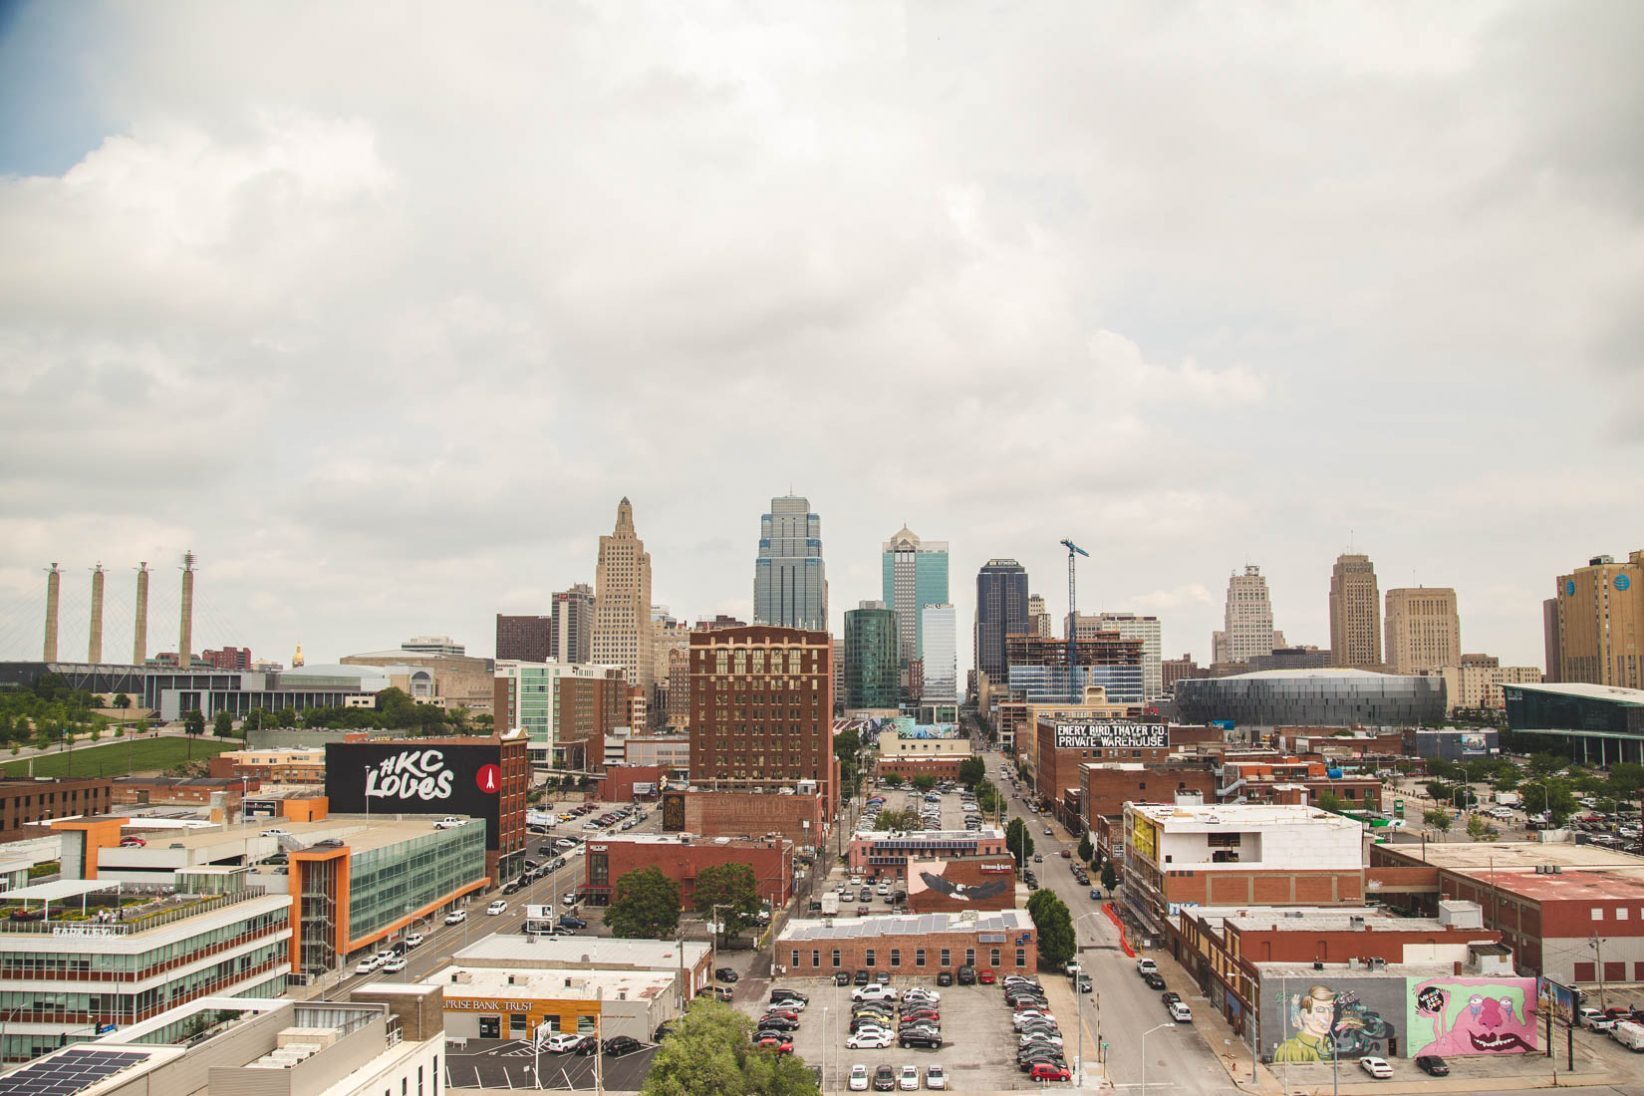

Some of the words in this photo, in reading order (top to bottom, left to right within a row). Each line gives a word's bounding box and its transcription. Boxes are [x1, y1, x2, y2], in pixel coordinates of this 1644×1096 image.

[1113, 725, 1148, 737] THAYER
[1151, 725, 1168, 736] CO.
[1058, 736, 1096, 747] PRIVATE
[1101, 736, 1164, 747] WAREHOUSE
[379, 750, 444, 777] #KC
[443, 1000, 471, 1009] PRISE
[473, 1001, 499, 1010] BANK
[505, 1002, 533, 1011] TRUST
